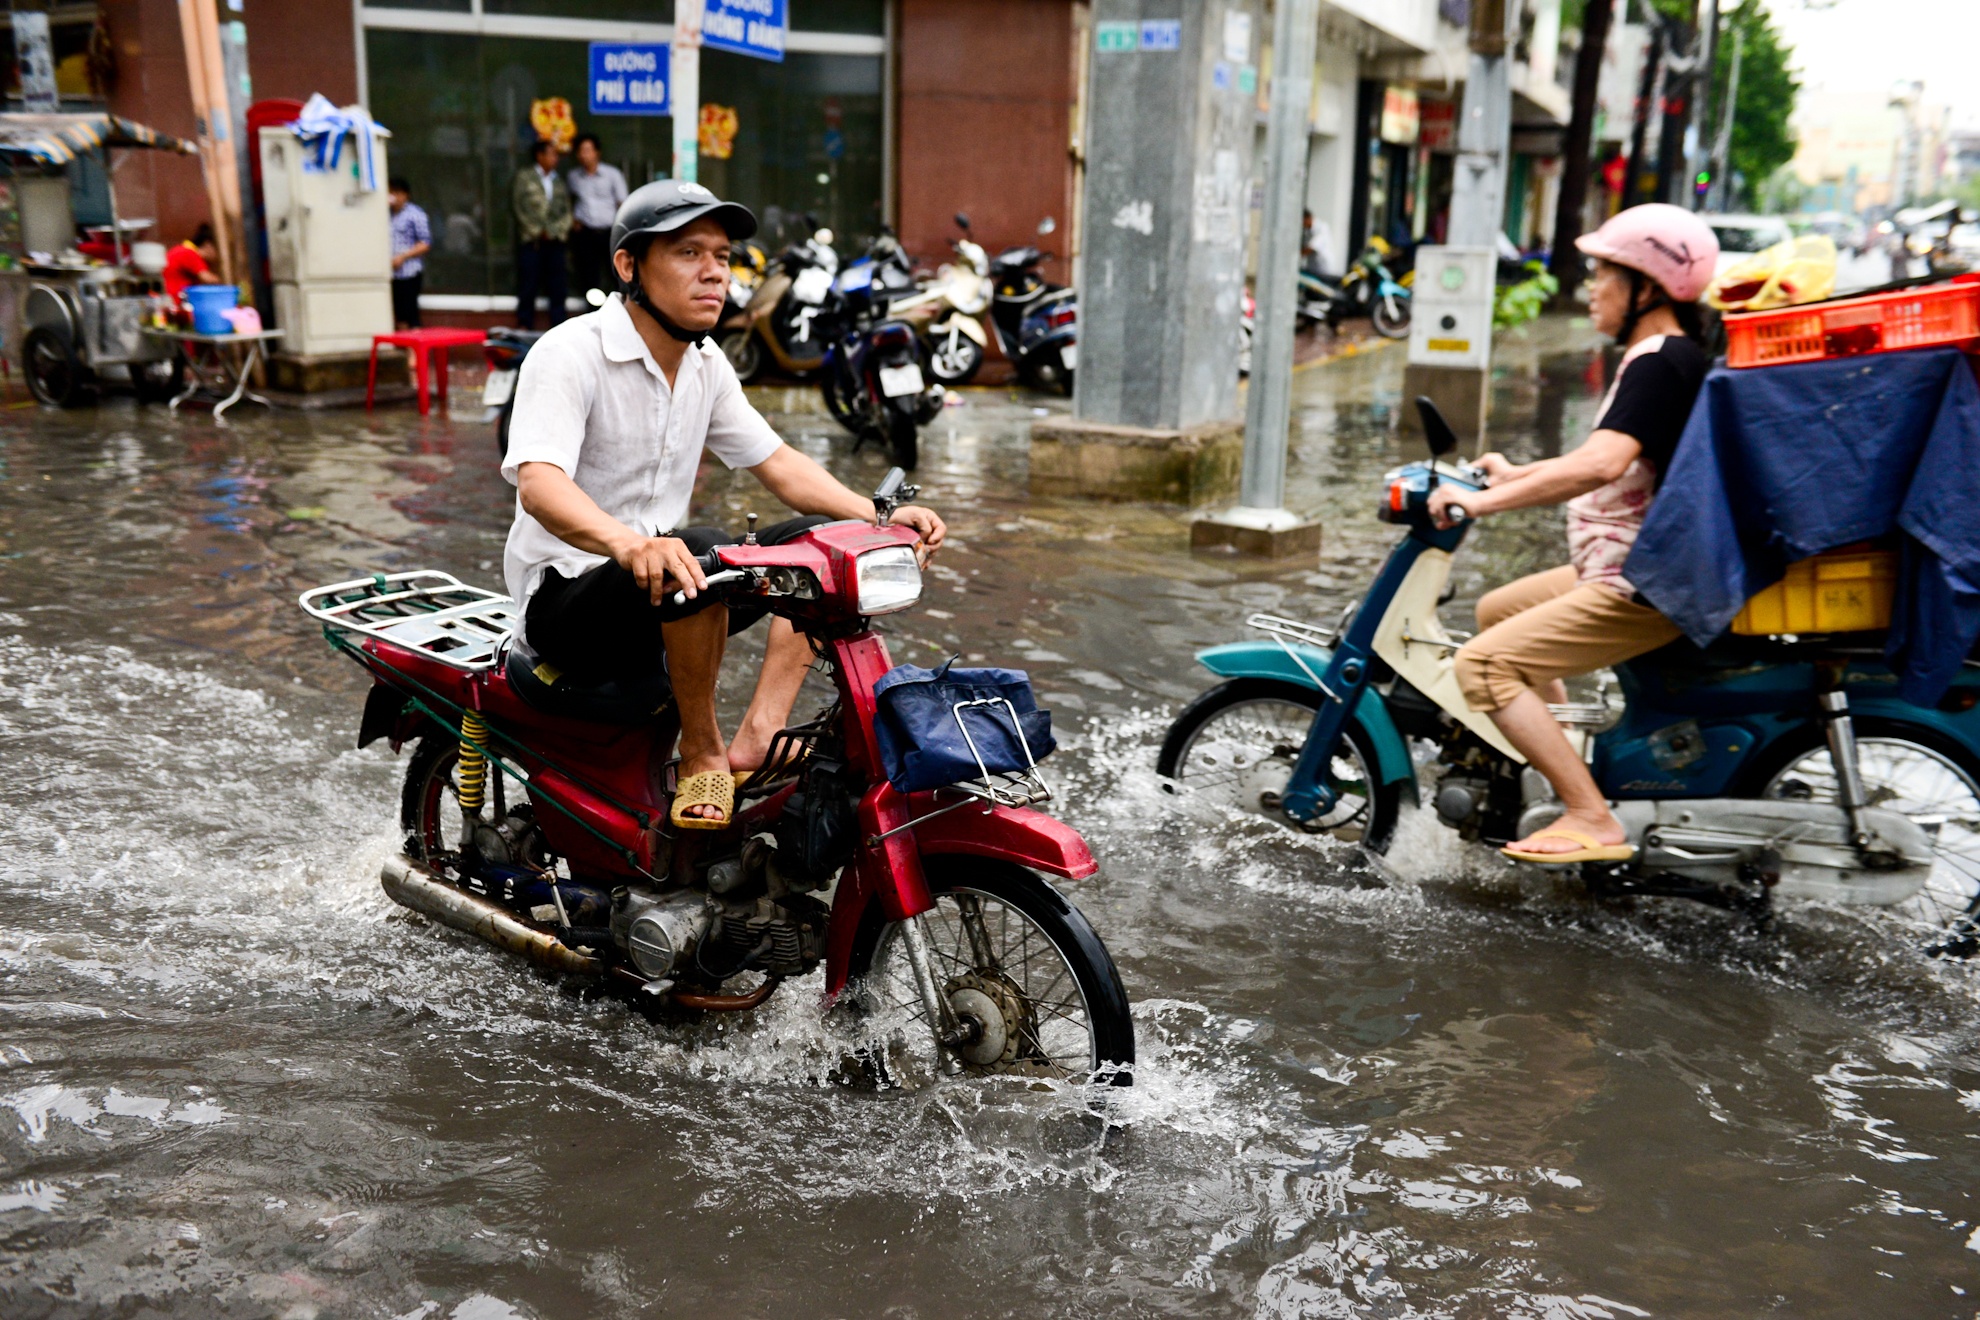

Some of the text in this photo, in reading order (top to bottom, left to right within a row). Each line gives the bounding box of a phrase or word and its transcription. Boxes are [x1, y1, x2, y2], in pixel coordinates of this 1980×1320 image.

[604, 49, 657, 73] ĐƯỜNG
[596, 74, 665, 104] PHÚ GIÁO
